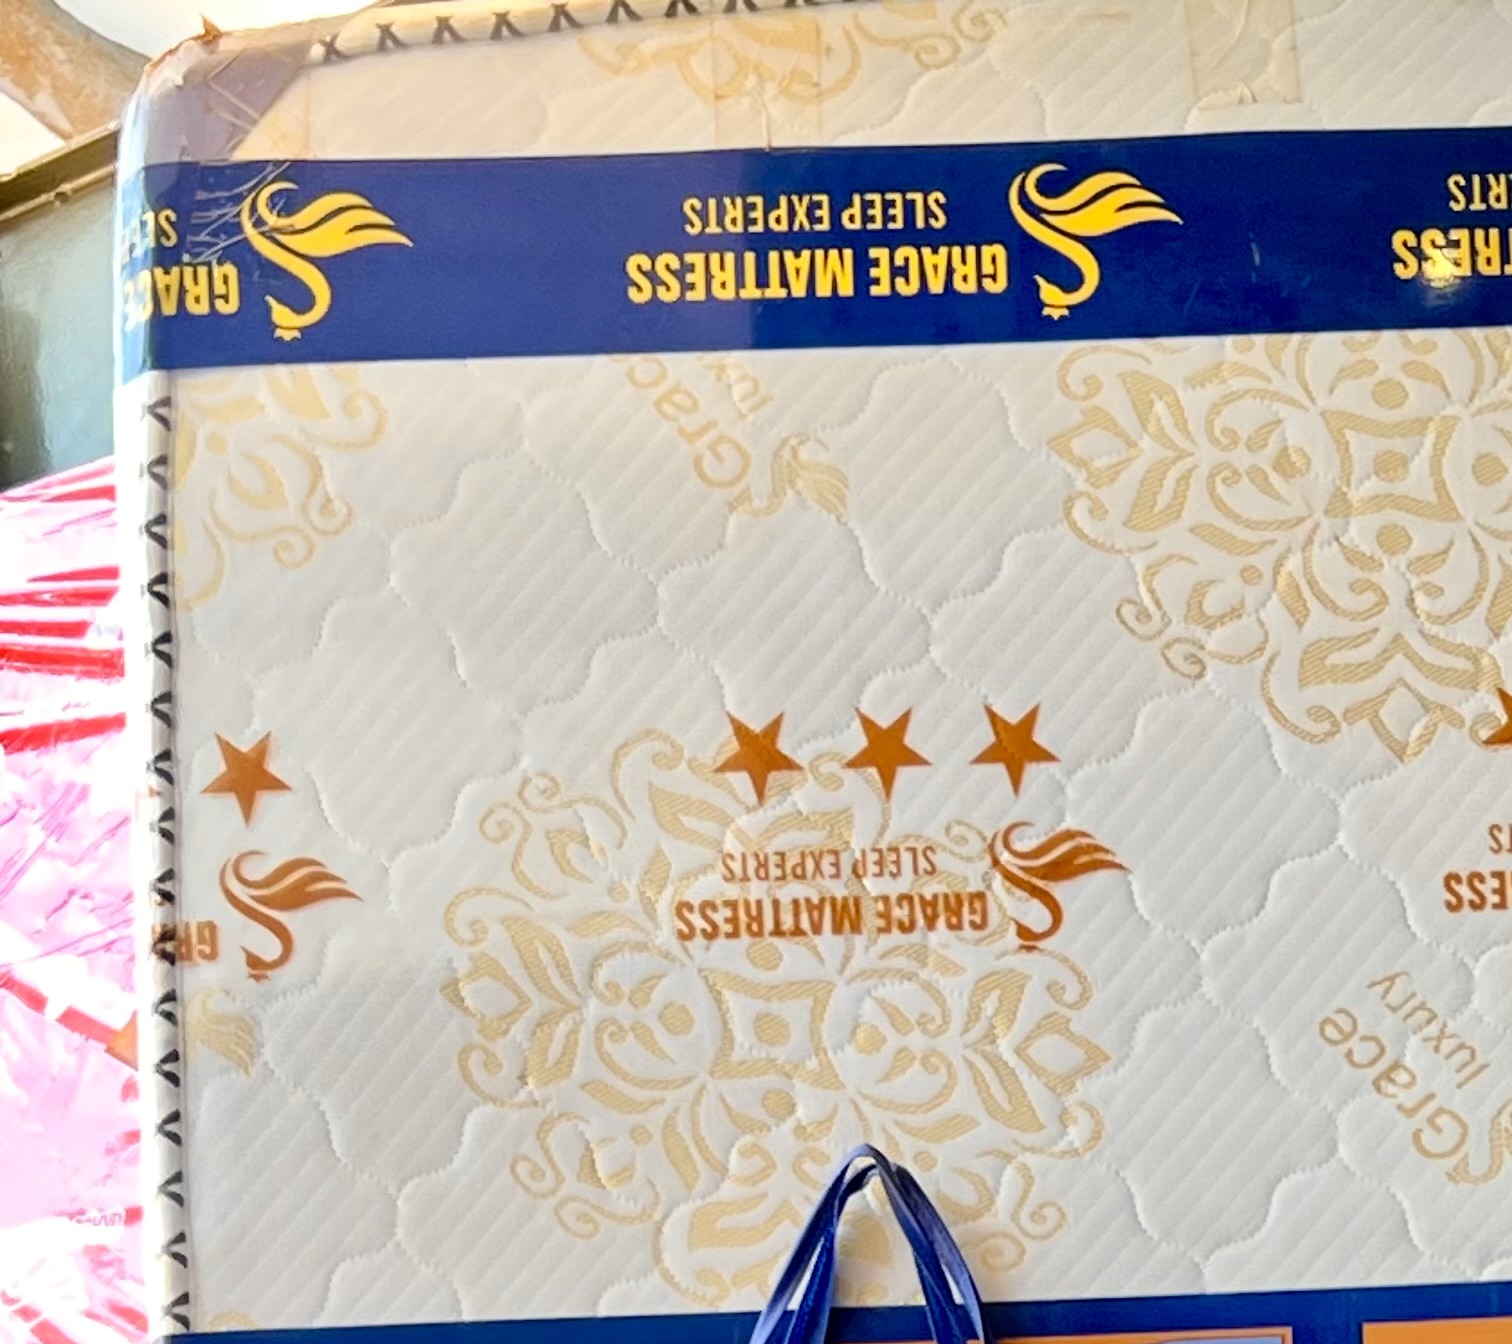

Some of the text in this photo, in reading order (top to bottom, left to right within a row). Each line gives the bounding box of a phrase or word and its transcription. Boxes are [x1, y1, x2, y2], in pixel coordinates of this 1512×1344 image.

[684, 190, 946, 235] SLEEP EXPERTS
[626, 243, 1008, 304] GRACE MATTRESS
[608, 353, 751, 489] Grac
[722, 845, 937, 882] SLEEP EXPERTS
[675, 890, 989, 941] GRACE MATTRESS
[1366, 971, 1490, 1089] luxury
[1318, 1008, 1469, 1160] Grace
